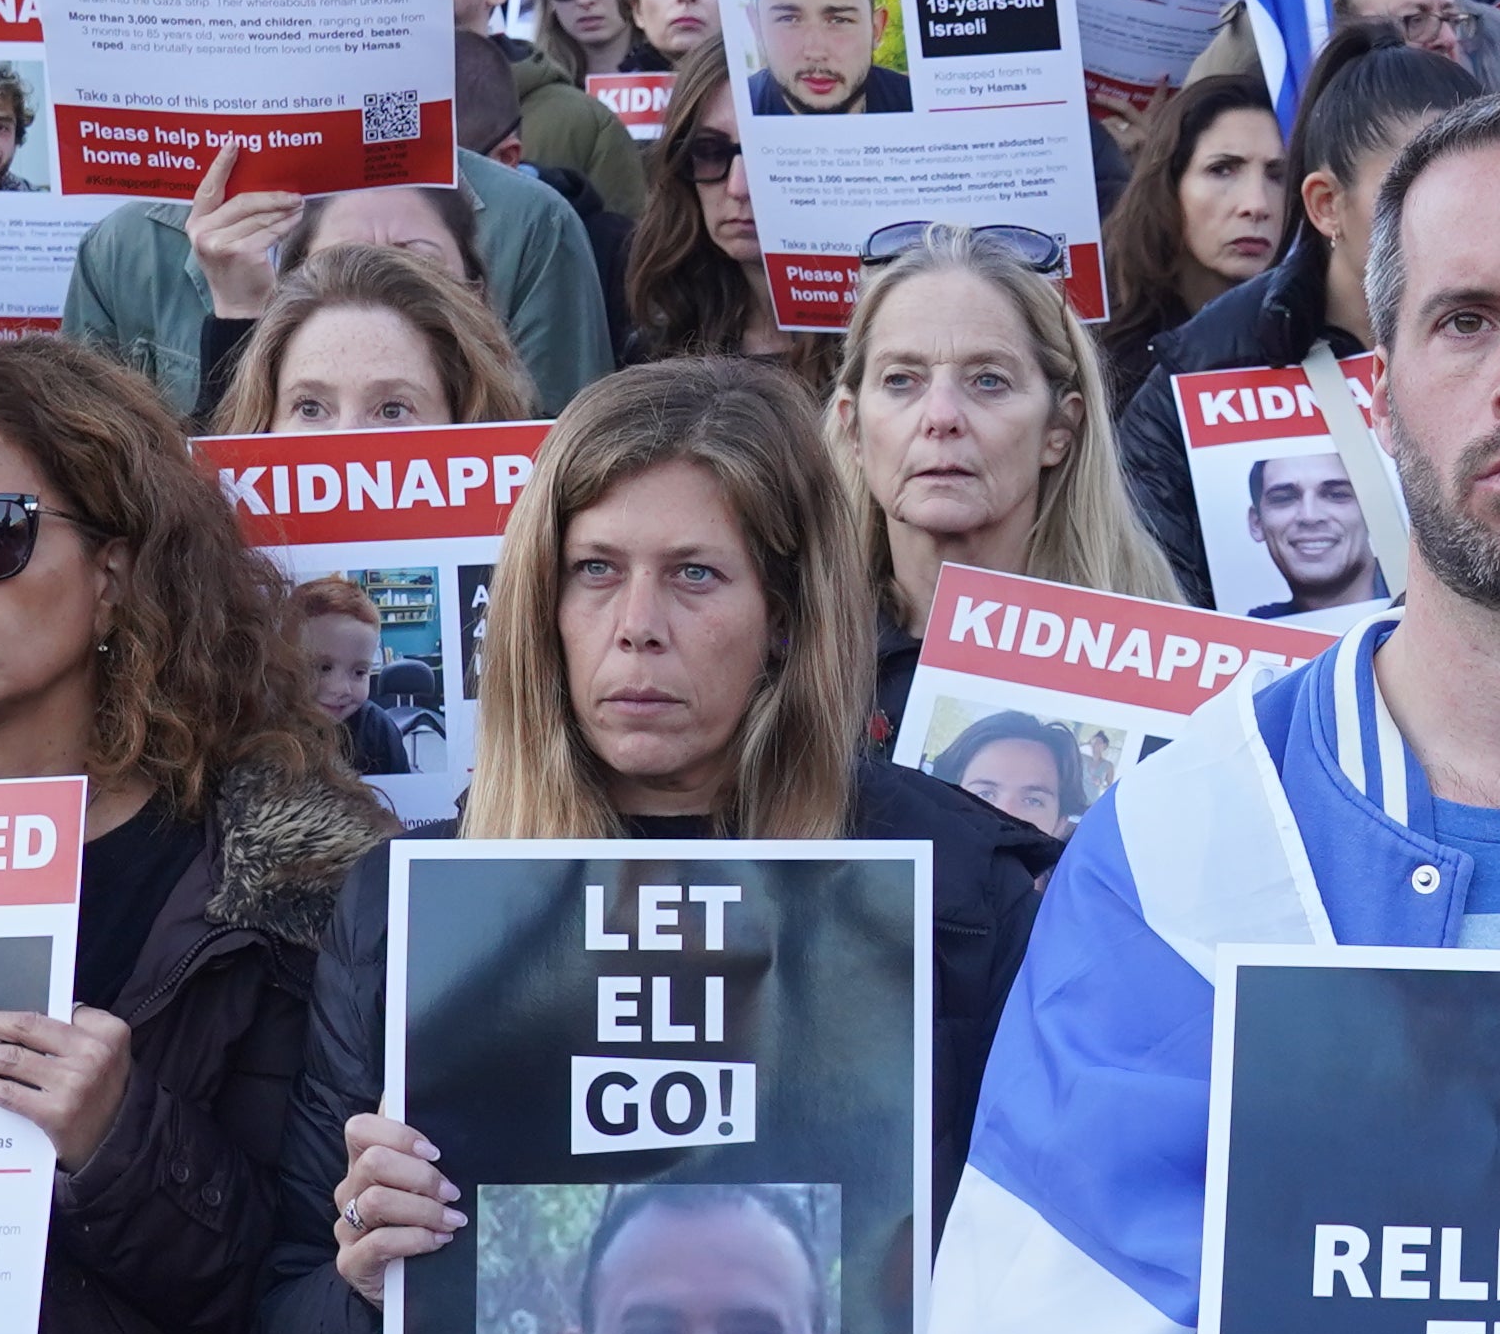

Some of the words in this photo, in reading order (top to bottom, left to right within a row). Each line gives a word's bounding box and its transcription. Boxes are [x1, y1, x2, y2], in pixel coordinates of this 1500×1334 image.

[928, 17, 987, 37] Israeli
[80, 121, 149, 143] Please
[154, 126, 200, 148] help
[205, 129, 262, 151] bring
[268, 130, 322, 148] them
[82, 146, 141, 166] home
[147, 151, 201, 170] alive.
[786, 266, 842, 283] Please
[790, 287, 839, 303] home
[585, 886, 741, 950] LET
[598, 977, 724, 1041] ELI
[586, 1070, 733, 1136] GO!
